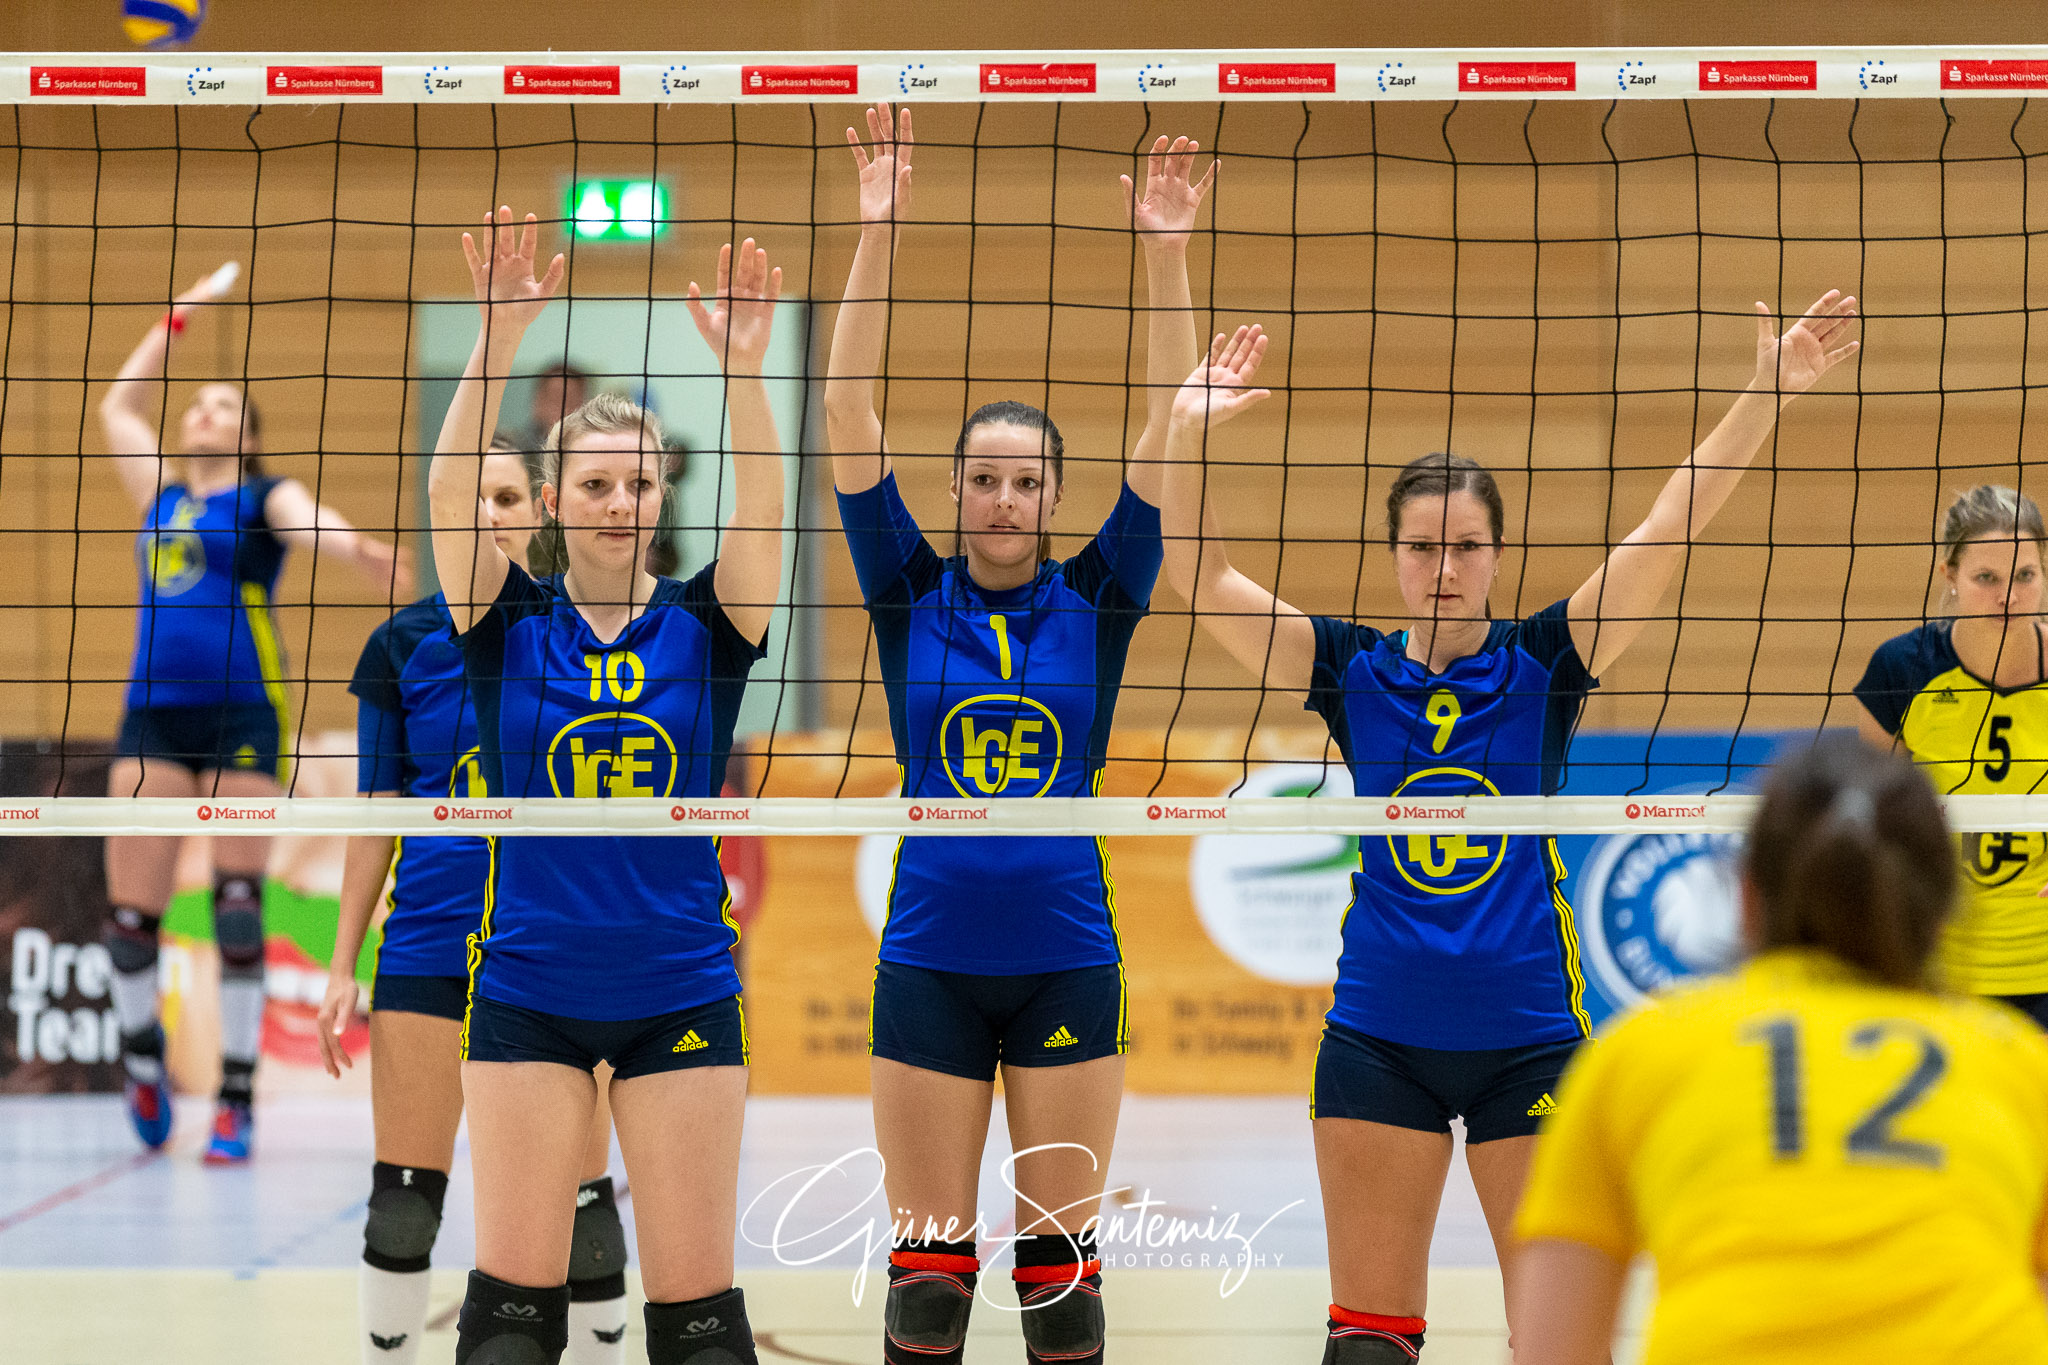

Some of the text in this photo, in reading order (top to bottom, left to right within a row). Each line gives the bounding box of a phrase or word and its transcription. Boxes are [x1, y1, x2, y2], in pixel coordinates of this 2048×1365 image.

[766, 77, 850, 89] Sparkasse Nürnberg
[911, 77, 937, 89] Zapf
[1004, 76, 1088, 88] Sparkasse Nürnberg
[1149, 76, 1176, 88] Zapf
[1243, 76, 1327, 88] Sparkasse Nürnberg
[1389, 75, 1416, 87] Zapf
[1483, 74, 1567, 86] Sparkasse Nürnberg
[1629, 74, 1656, 86] Zapf
[1723, 73, 1807, 85] Sparkasse Nürnberg
[1870, 73, 1897, 85] Zapf
[1965, 72, 2008, 83] Sparkasse
[54, 79, 138, 91] Sparkasse Nürnberg
[198, 79, 225, 91] Zapf
[291, 78, 375, 90] Sparkasse Nürnberg
[435, 78, 462, 90] Zapf
[528, 78, 612, 90] Sparkasse Nürnberg
[673, 78, 700, 90] Zapf
[989, 614, 1012, 680] 1
[583, 650, 646, 703] 10
[1425, 688, 1462, 754] 9
[1984, 715, 2012, 782] 5
[960, 716, 1044, 795] IGE
[0, 807, 39, 820] rmot
[214, 807, 276, 820] Marmot
[451, 807, 512, 820] Marmot
[688, 807, 750, 820] Marmot
[926, 807, 987, 820] Marmot
[1164, 807, 1226, 819] Marmot
[1403, 806, 1465, 819] Marmot
[1643, 805, 1705, 818] Marmot
[672, 1040, 709, 1053] adidas
[1043, 1037, 1079, 1048] adidas
[1737, 1015, 1947, 1172] 12
[1526, 1106, 1562, 1117] adida
